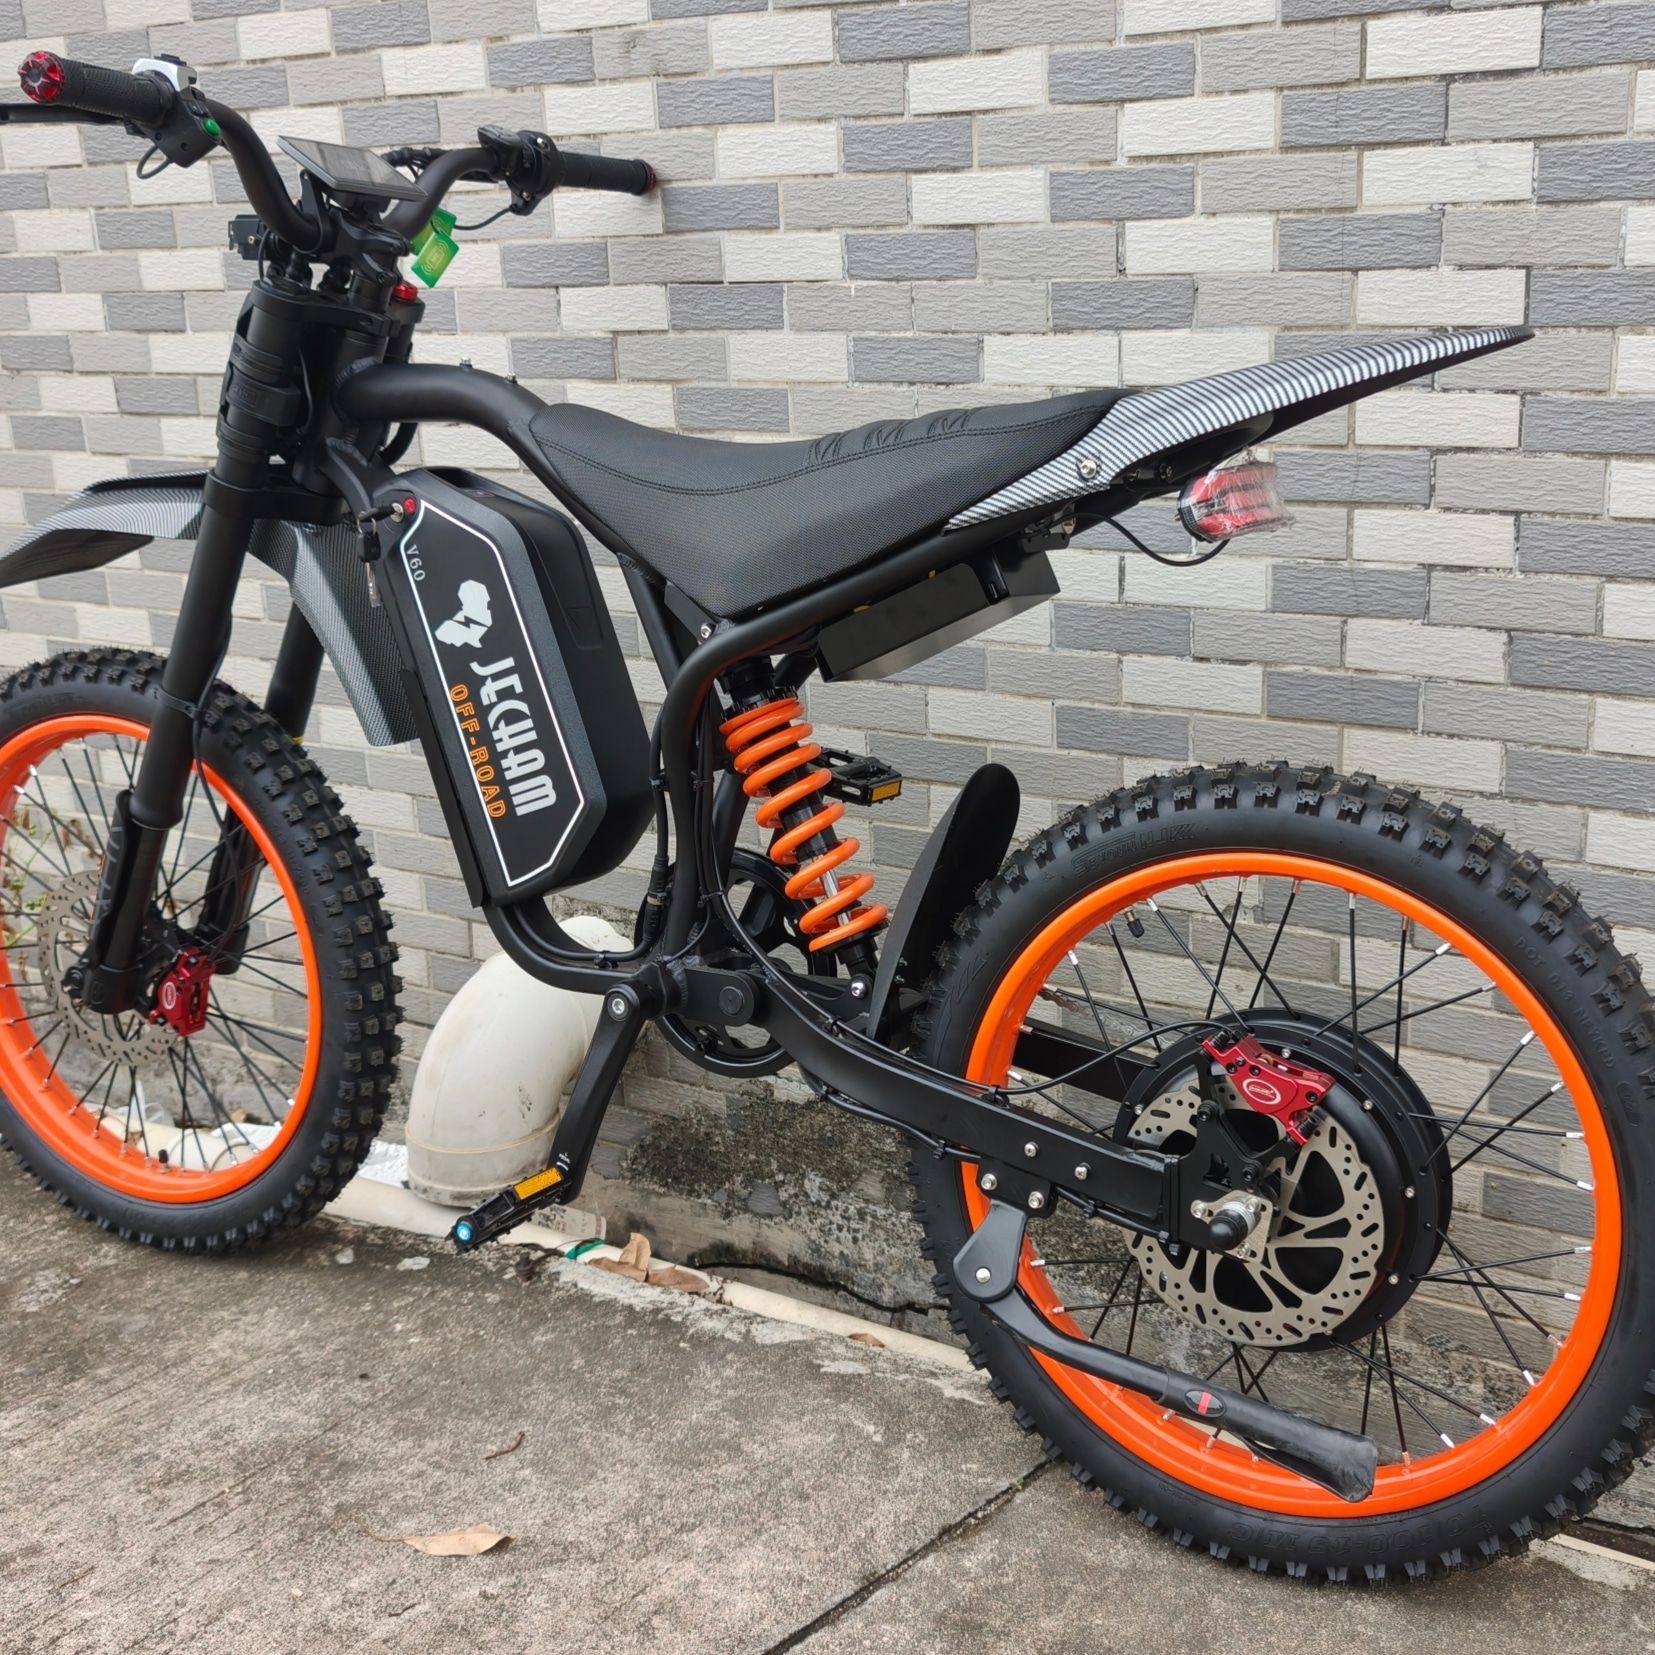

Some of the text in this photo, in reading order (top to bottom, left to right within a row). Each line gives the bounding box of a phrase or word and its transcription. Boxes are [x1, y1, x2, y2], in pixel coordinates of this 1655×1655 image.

[407, 544, 426, 582] V60
[449, 683, 508, 819] OFF-ROAD
[469, 656, 557, 817] JECHAM
